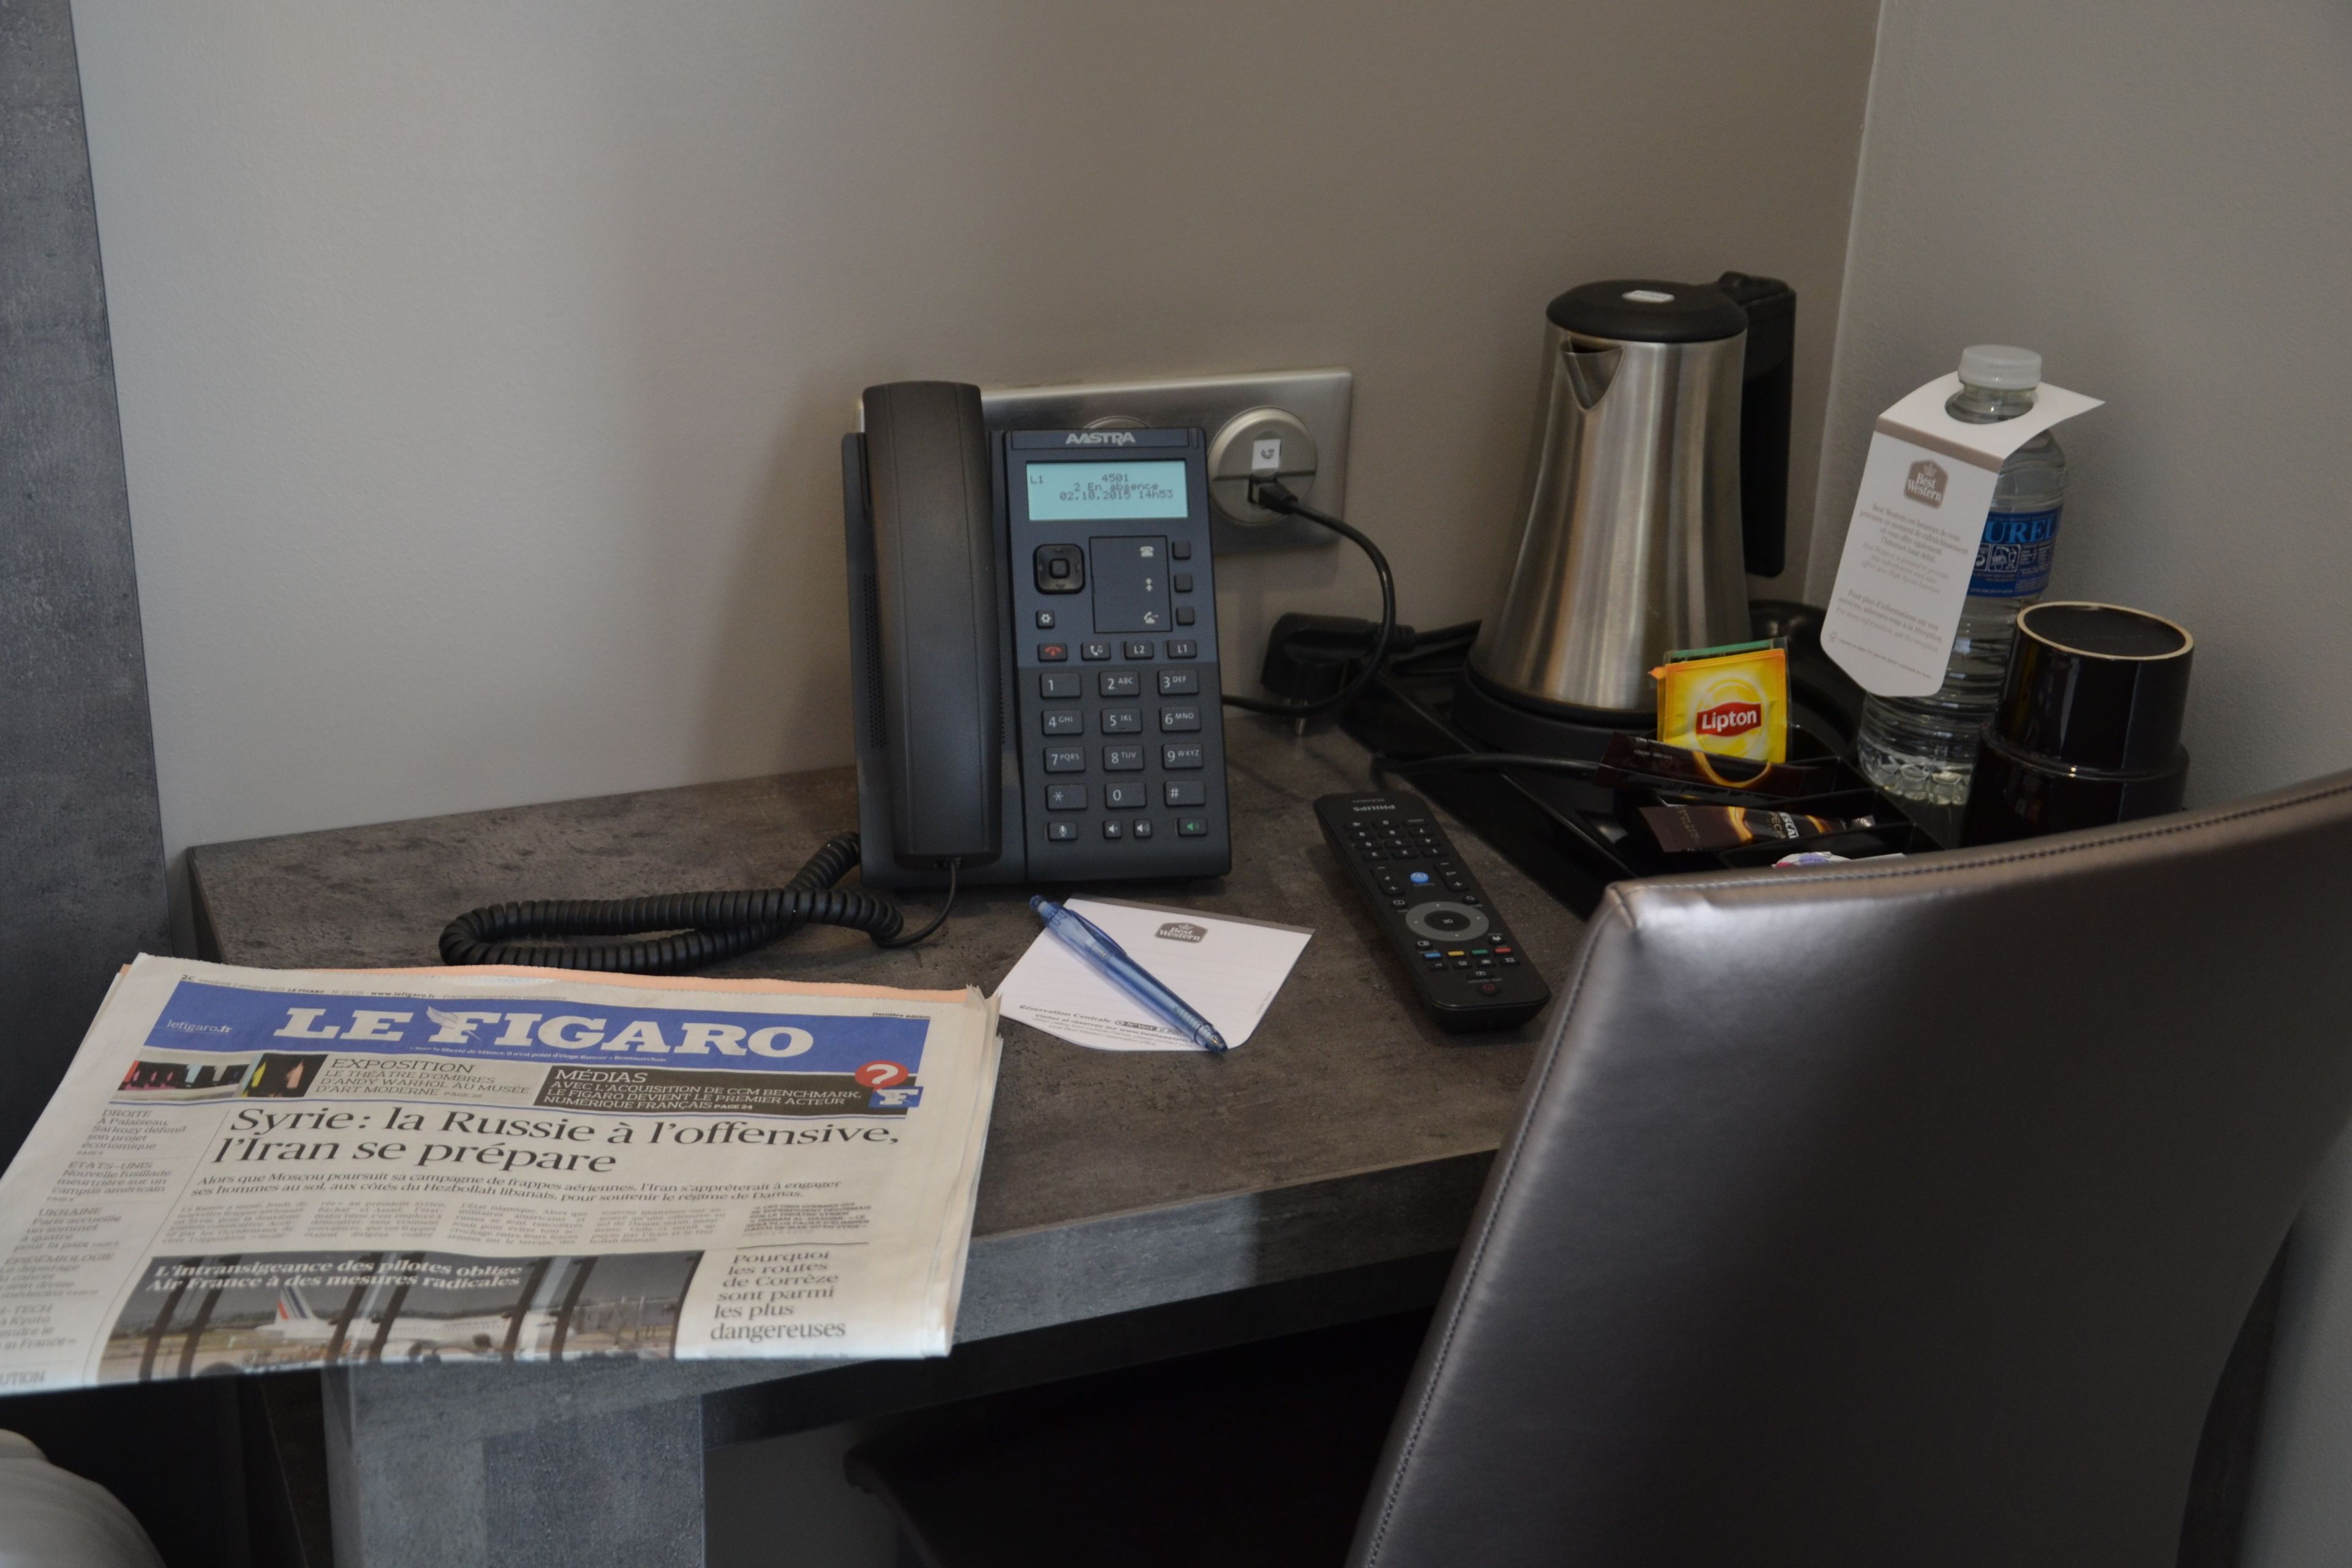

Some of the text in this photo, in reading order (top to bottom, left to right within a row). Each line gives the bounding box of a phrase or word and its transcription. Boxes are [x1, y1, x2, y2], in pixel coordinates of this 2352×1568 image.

[1066, 432, 1136, 446] AASTRA
[1030, 473, 1129, 484] L1 4501
[1916, 472, 1937, 489] Best
[1074, 483, 1080, 491] 2
[1109, 481, 1159, 491] absence
[1907, 479, 1942, 501] Western
[1060, 489, 1174, 501] 02.10.2015 14h53
[1134, 645, 1145, 654] L2
[1177, 644, 1188, 654] L1
[1048, 680, 1054, 691] 1
[1107, 678, 1115, 690] 2
[1164, 676, 1170, 688] 3
[1048, 716, 1057, 728] 4
[1110, 715, 1117, 726] 5
[1164, 713, 1173, 725] 6
[1701, 709, 1758, 733] Lipton
[1051, 753, 1059, 766] 7
[1111, 752, 1119, 763] 8
[1167, 750, 1175, 762] 9
[1112, 789, 1121, 801] 0
[1170, 787, 1180, 799] #
[1159, 929, 1200, 941] Western
[1170, 927, 1193, 935] Best
[1073, 1012, 1112, 1023] Centrale
[166, 1019, 233, 1034] lefigaro.fr
[273, 1006, 814, 1058] LE FIGARO
[330, 1058, 476, 1073] EXPOSITION
[554, 1068, 649, 1084] MÉDIAS
[315, 1085, 363, 1093] D'ART
[364, 1086, 439, 1096] MODERNE
[320, 1076, 531, 1095] D'ANDY WARHOL AU MUSÉE
[551, 1080, 596, 1091] AVEC
[597, 1083, 701, 1094] L'ACQUISITION
[703, 1086, 724, 1095] DE
[726, 1087, 761, 1096] CCM
[543, 1095, 633, 1109] NUMÉRIQUE
[635, 1100, 713, 1111] FRANÇAIS
[568, 1089, 624, 1100] FIGARO
[626, 1092, 692, 1102] DEVIENT
[695, 1094, 714, 1102] LE
[715, 1095, 782, 1104] PREMIER
[784, 1096, 846, 1106] ACTEUR
[102, 1109, 153, 1118] DROITE
[92, 1125, 187, 1134] Sarkozy défend
[383, 1110, 423, 1133] la
[437, 1110, 595, 1142] Russie
[607, 1121, 634, 1144] à
[647, 1120, 899, 1145] l'offensive,
[110, 1133, 148, 1144] projet
[81, 1141, 157, 1152] économique
[213, 1136, 617, 1173] l'Iran se prépare
[62, 1169, 172, 1178] Nouvelle fusillade
[197, 1174, 236, 1186] Alors
[238, 1173, 266, 1183] que
[268, 1172, 325, 1182] Moscou
[326, 1171, 388, 1183] poursuit
[409, 1174, 484, 1185] campagne
[486, 1176, 505, 1186] de
[506, 1177, 562, 1191] frappes
[640, 1182, 677, 1192] l'Iran
[680, 1182, 770, 1194] s'apprêterait
[774, 1181, 782, 1190] à
[785, 1180, 842, 1191] engager
[51, 1185, 167, 1197] campus américain
[190, 1188, 214, 1197] ses
[216, 1184, 279, 1194] hommes
[329, 1182, 356, 1191] aux
[360, 1182, 399, 1192] côtés
[401, 1183, 420, 1192] du
[424, 1183, 496, 1196] Hezbollah
[560, 1193, 598, 1203] pour
[600, 1193, 660, 1202] soutenir
[677, 1192, 729, 1202] régime
[731, 1191, 750, 1200] de
[734, 1250, 831, 1265] Pourquoi
[154, 1257, 524, 1280] L'intransigeance des pilotes oblige
[728, 1262, 829, 1276] les routes
[145, 1272, 521, 1292] Air France à des mesures radicales
[723, 1273, 839, 1288] de Corrèze
[717, 1286, 835, 1303] sont parmi
[713, 1302, 794, 1321] les plus
[709, 1322, 847, 1343] dangereuses
